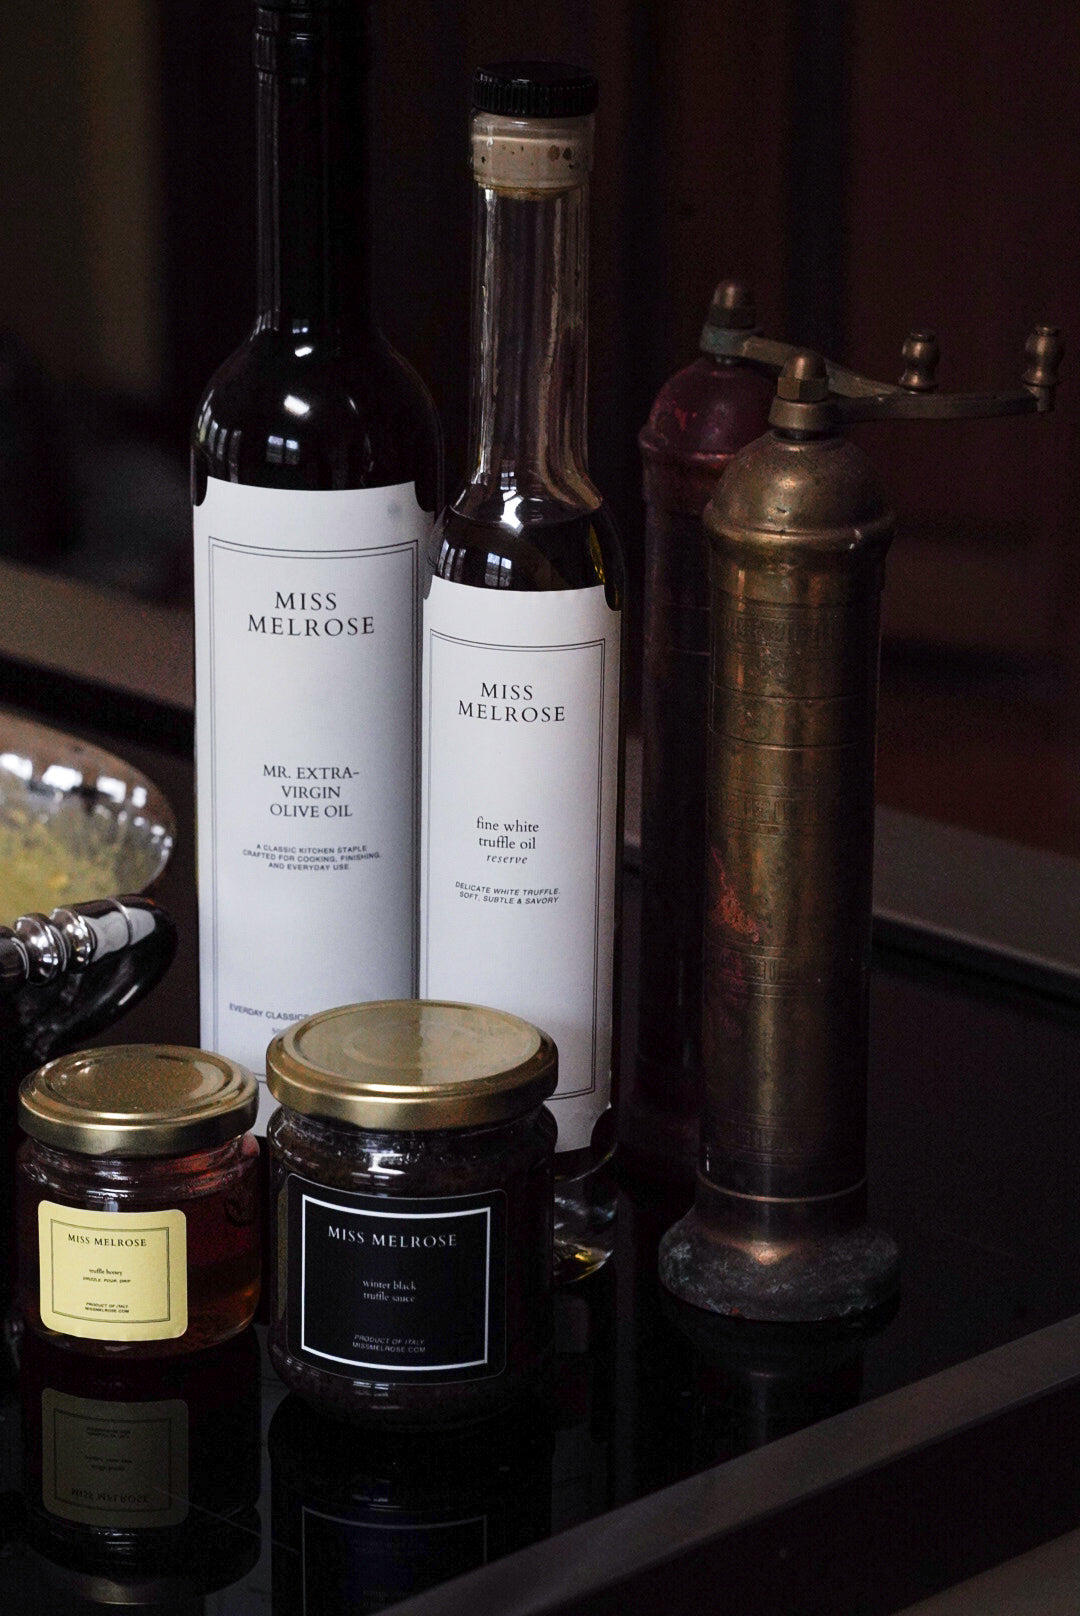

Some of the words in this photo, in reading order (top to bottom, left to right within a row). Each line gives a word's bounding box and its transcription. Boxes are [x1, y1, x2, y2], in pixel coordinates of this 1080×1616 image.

[275, 591, 337, 611] MISS
[248, 614, 375, 637] MELROSE
[480, 682, 534, 701] MISS
[458, 700, 566, 723] MELROSE
[263, 764, 291, 779] MR.
[296, 766, 360, 780] EXTRA-
[281, 786, 341, 799] VIRGIN
[270, 804, 320, 818] OLIVE
[324, 805, 353, 818] OIL
[476, 816, 500, 832] fine
[504, 818, 540, 833] white
[263, 844, 297, 853] CLASSIC
[299, 846, 335, 854] KITCHEN
[337, 844, 368, 854] STAPLE
[479, 835, 516, 850] truffle
[519, 837, 537, 850] oil
[243, 849, 275, 860] CRAFTED
[278, 854, 295, 862] FOR
[487, 854, 528, 865] reserve
[268, 862, 285, 870] AND
[287, 863, 330, 871] EVERYDAY
[455, 881, 492, 893] DELICATE
[493, 887, 520, 896] WHITE
[483, 895, 515, 904] SUBTLE
[525, 896, 560, 905] SAVORY
[68, 1233, 90, 1245] MISS
[94, 1238, 147, 1248] MELROSE
[328, 1225, 364, 1244] MISS
[372, 1233, 458, 1248] MELROSE
[362, 1280, 391, 1290] winter
[393, 1280, 417, 1291] black
[363, 1290, 390, 1302] truffle
[392, 1295, 416, 1303] sauce
[354, 1334, 390, 1345] PRODUCT
[391, 1338, 401, 1346] OF
[404, 1338, 426, 1346] ITALY
